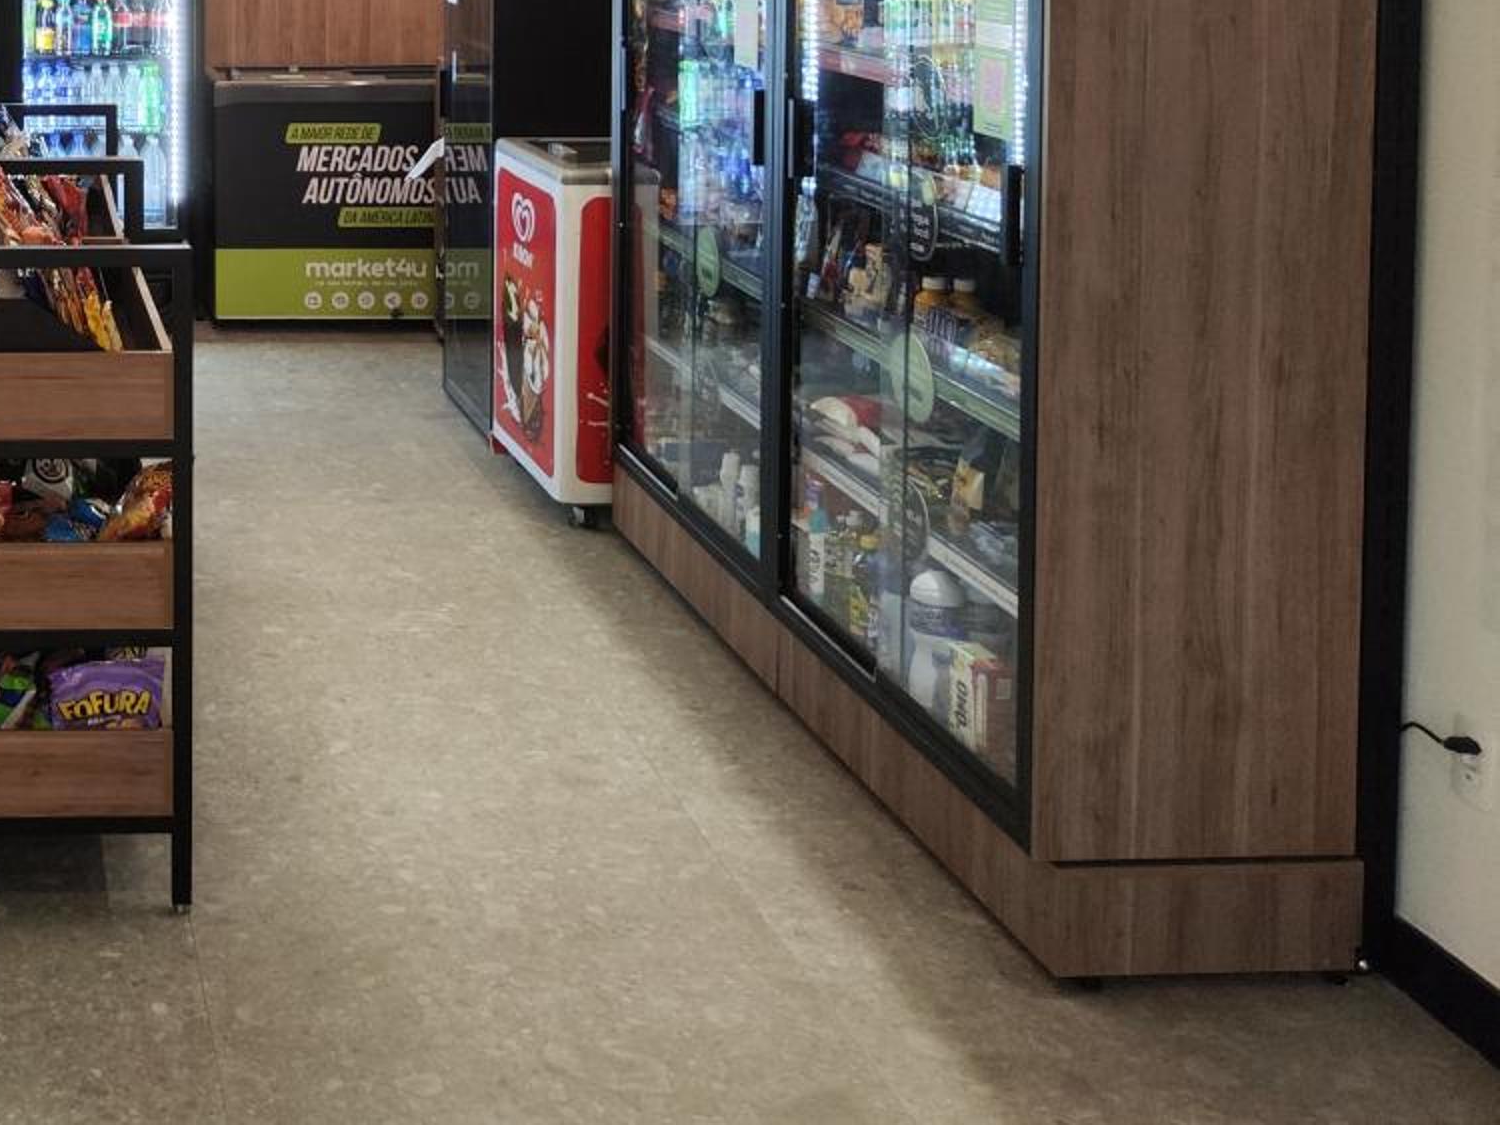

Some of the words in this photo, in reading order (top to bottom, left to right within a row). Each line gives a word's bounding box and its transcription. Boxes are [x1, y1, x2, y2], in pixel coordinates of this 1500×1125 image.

[297, 145, 419, 172] MERCADOS
[302, 173, 437, 204] AUTÔNOMOS
[304, 258, 428, 279] market4u
[58, 690, 151, 720] FOFURA
